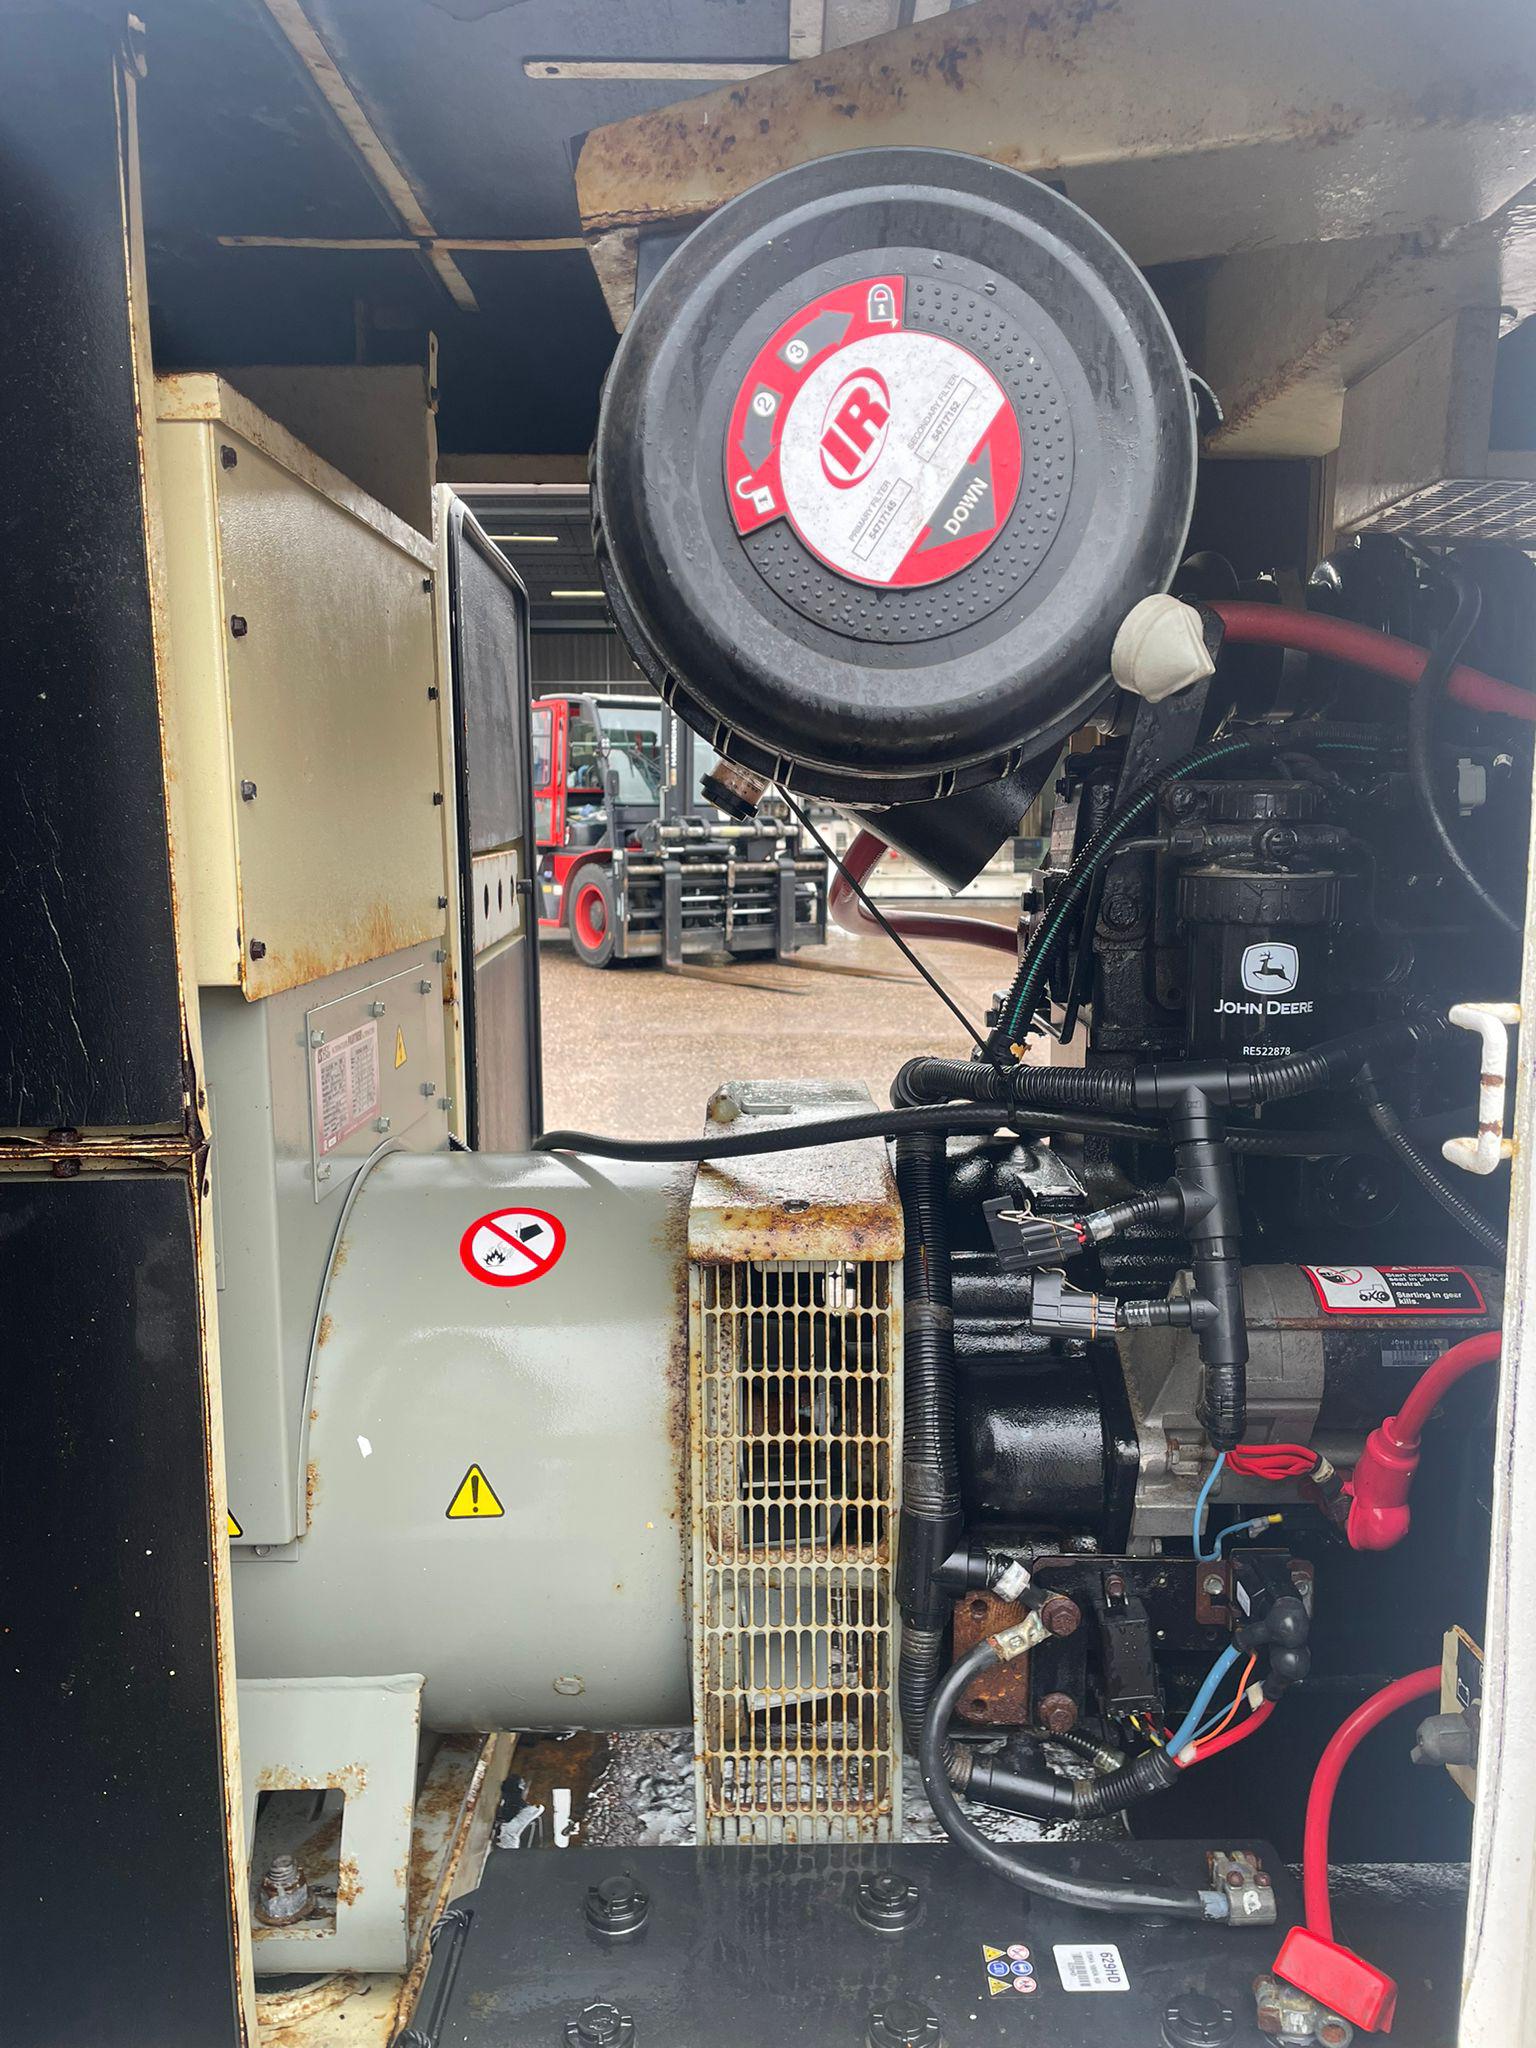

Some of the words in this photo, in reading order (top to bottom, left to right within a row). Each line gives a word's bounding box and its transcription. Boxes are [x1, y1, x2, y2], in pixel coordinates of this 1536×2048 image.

[789, 344, 804, 359] 3
[756, 395, 772, 411] 2
[906, 398, 943, 451] SECONDARY
[937, 372, 960, 402] FILTER
[820, 386, 890, 476] IR
[931, 400, 962, 443] 54717152
[848, 508, 873, 543] PRIMARY
[868, 479, 891, 510] FILTER
[943, 476, 989, 536] DOWN
[1214, 998, 1263, 1015] JOHN
[1266, 1000, 1314, 1015] DEERE
[1243, 1046, 1291, 1056] RE522878
[1396, 1291, 1431, 1300] Starting
[1442, 1292, 1462, 1300] gear
[1101, 1952, 1120, 1983] 629HD
